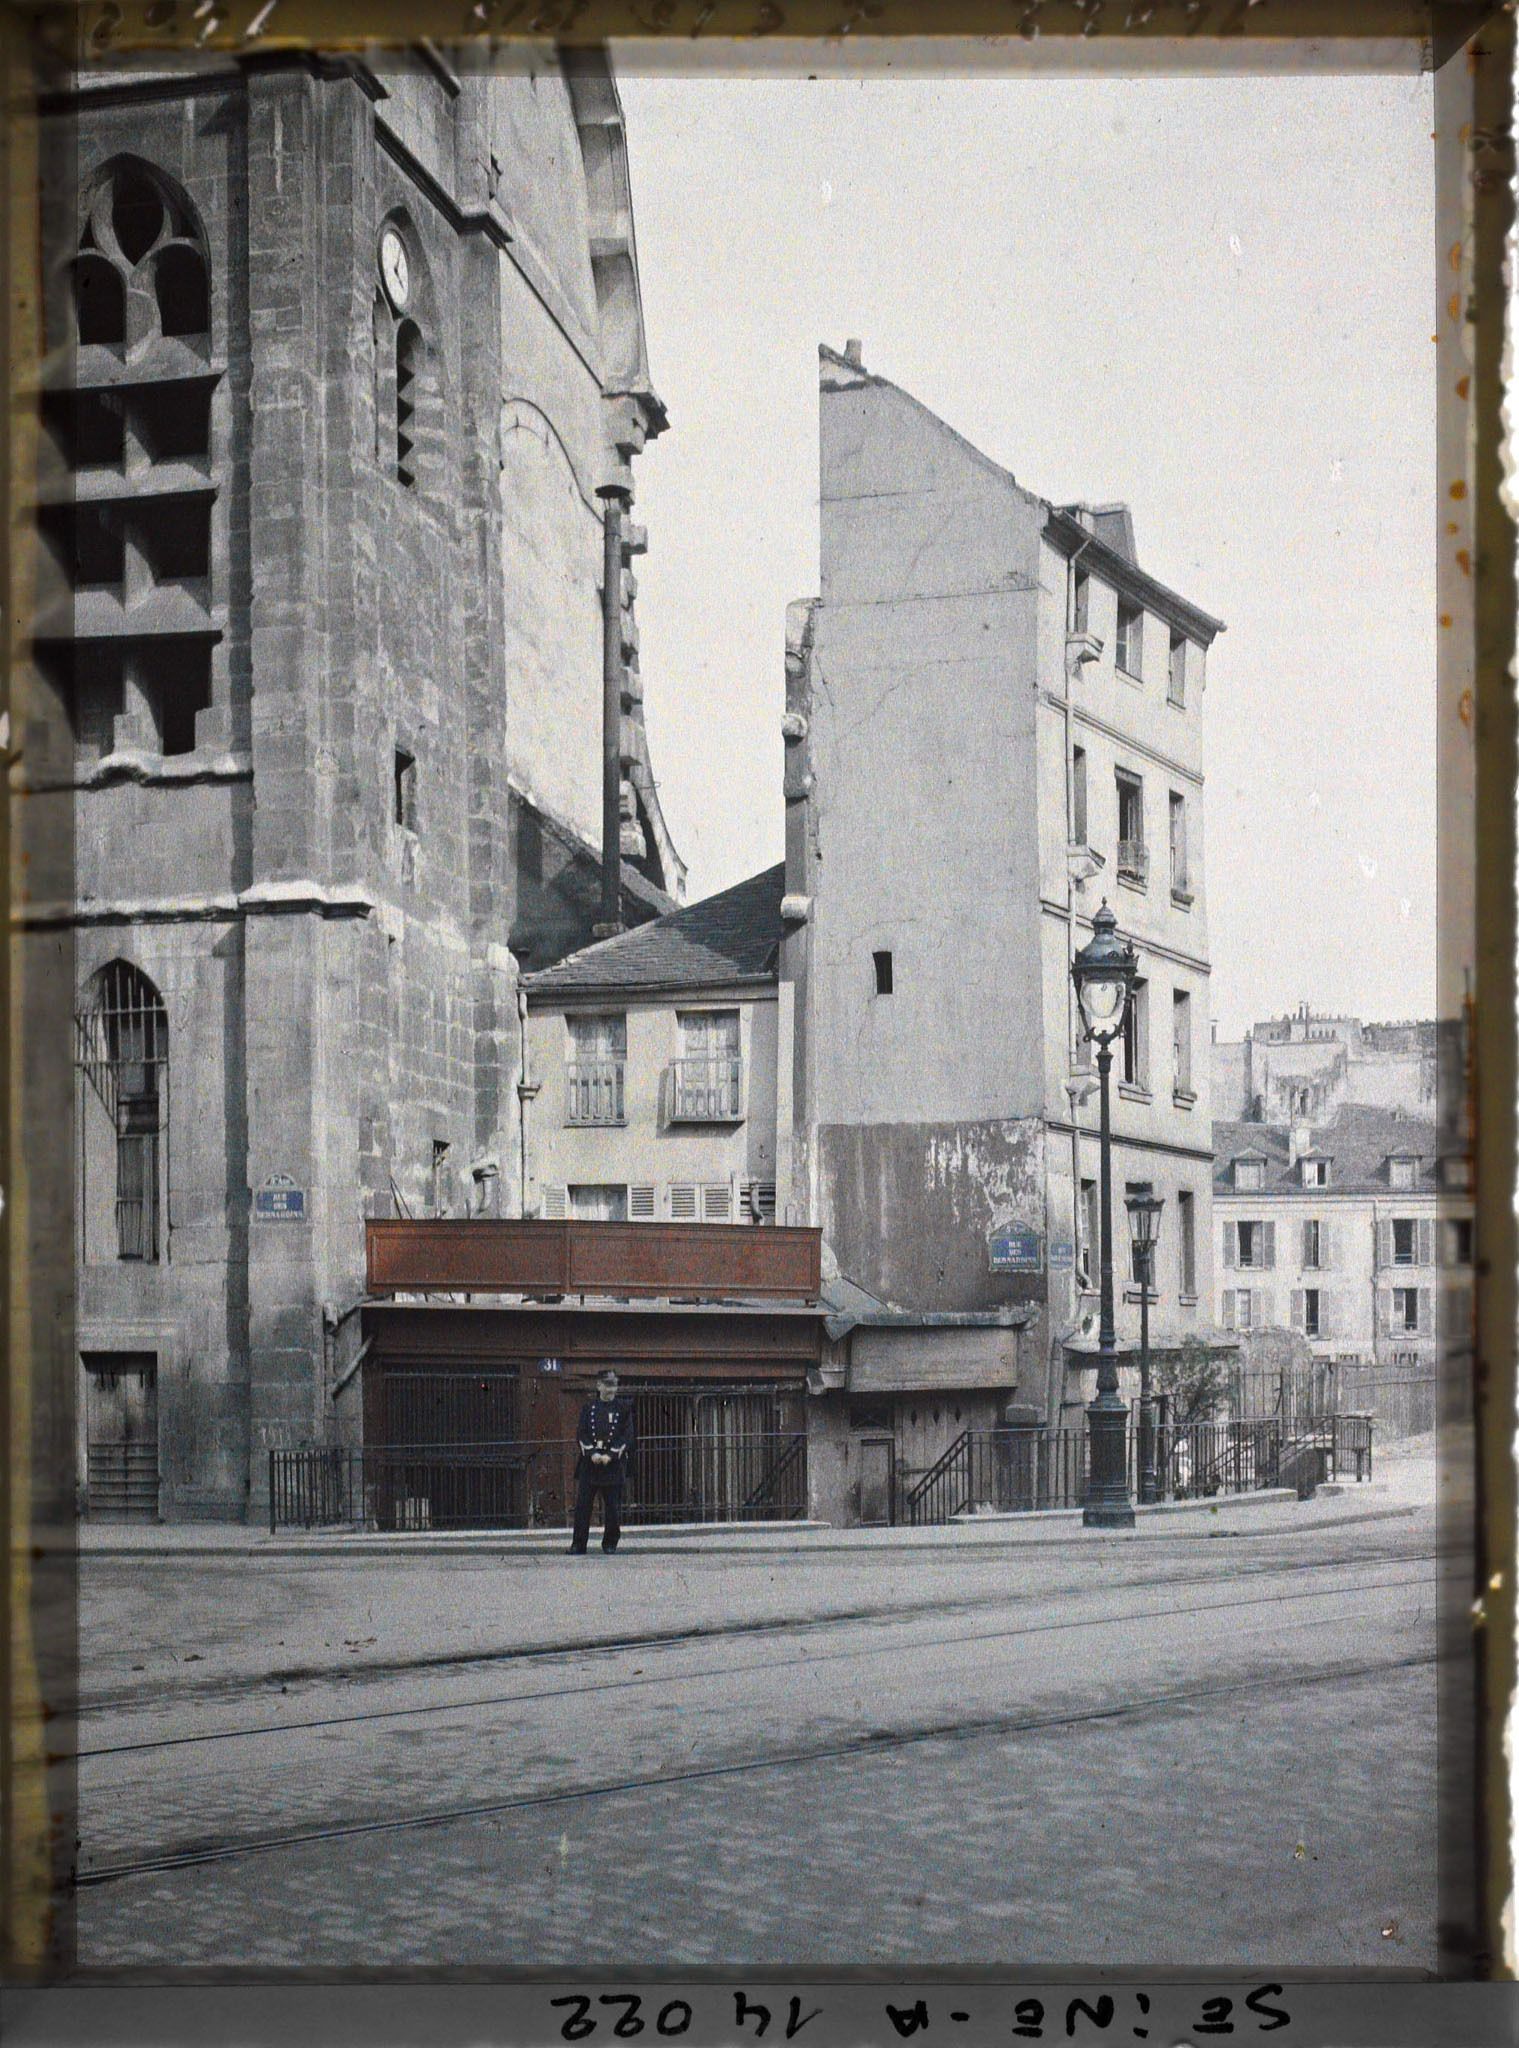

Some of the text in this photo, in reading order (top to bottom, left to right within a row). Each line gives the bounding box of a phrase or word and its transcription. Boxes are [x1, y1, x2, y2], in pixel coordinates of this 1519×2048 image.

[543, 1357, 558, 1371] 31
[550, 1993, 693, 2041] 022
[733, 1991, 824, 2040] 14
